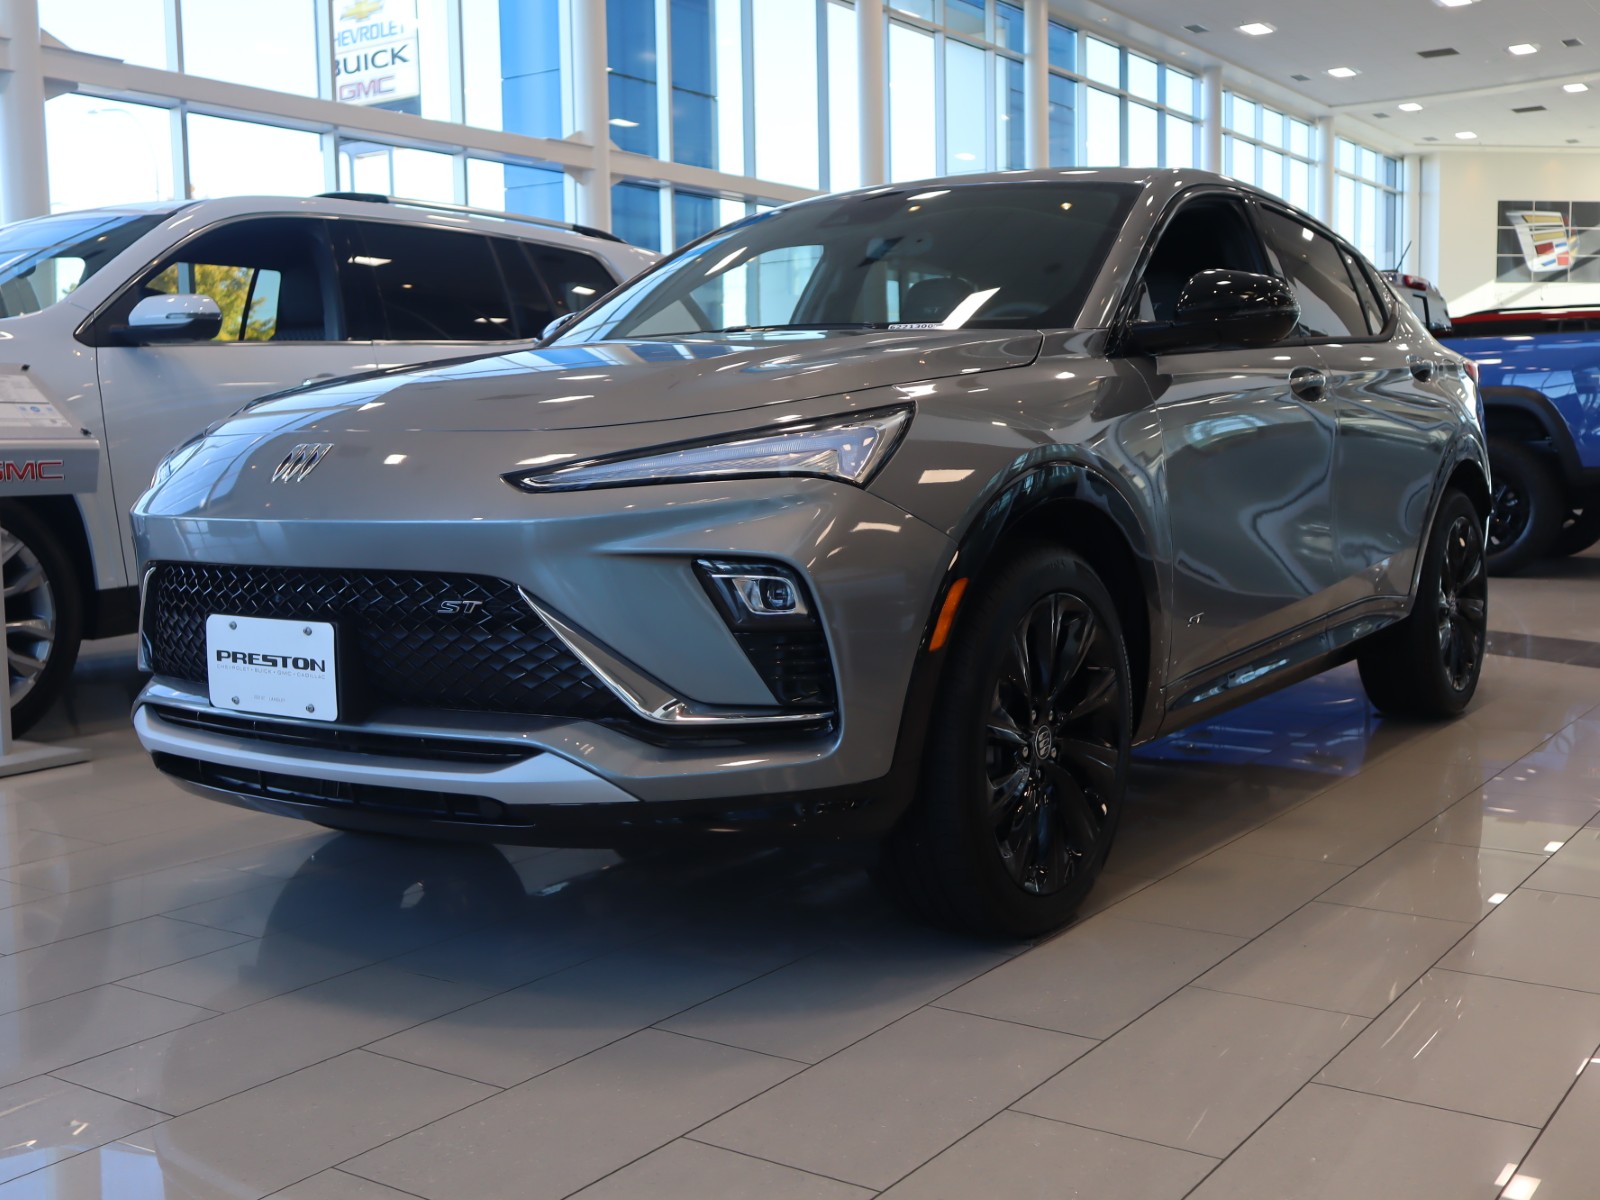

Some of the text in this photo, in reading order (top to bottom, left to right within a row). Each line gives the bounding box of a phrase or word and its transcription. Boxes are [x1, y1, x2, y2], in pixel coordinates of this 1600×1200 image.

[339, 75, 395, 100] GMC
[0, 460, 64, 480] MC
[438, 600, 482, 613] ST
[216, 650, 325, 672] PRESTON
[217, 664, 250, 672] CHEVROLET
[296, 672, 326, 680] CADILLAC
